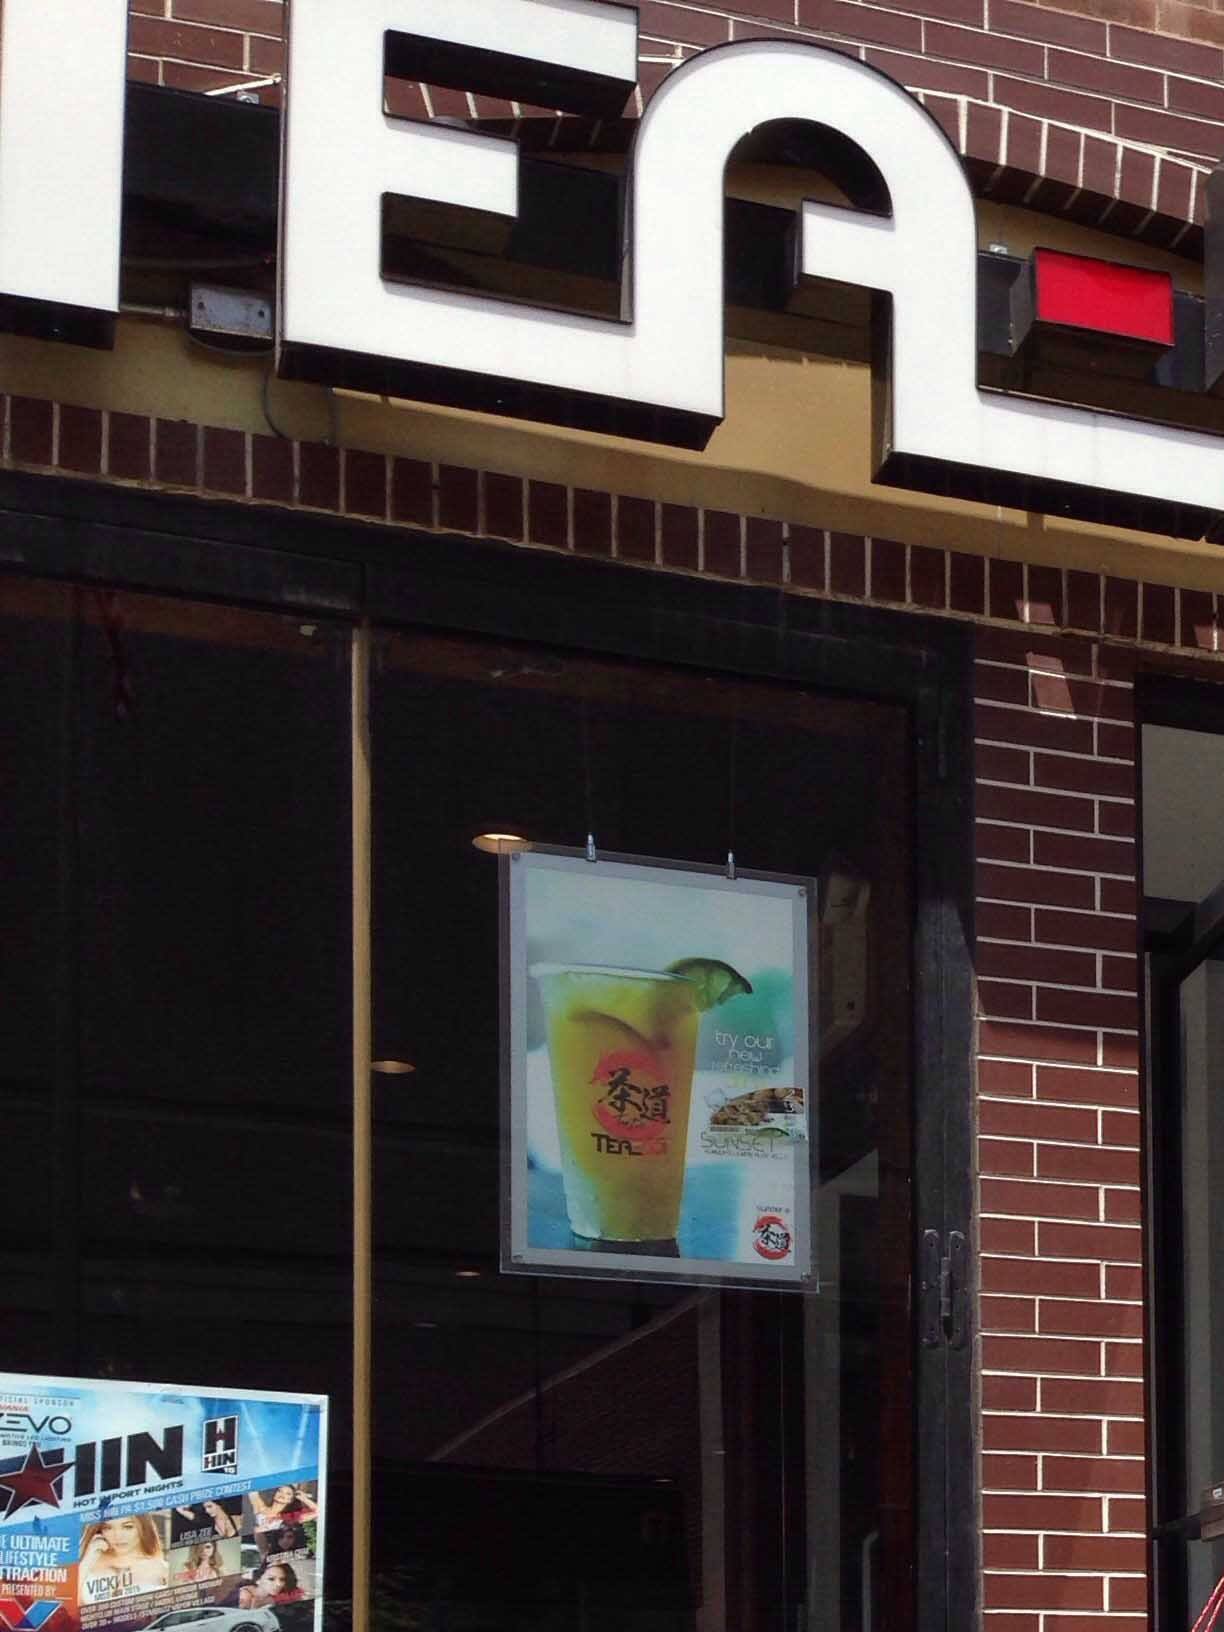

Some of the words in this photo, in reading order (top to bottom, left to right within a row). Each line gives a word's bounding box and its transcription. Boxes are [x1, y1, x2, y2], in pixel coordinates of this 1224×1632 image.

[714, 1031, 738, 1047] try
[744, 1035, 775, 1049] our
[73, 1498, 97, 1508] HOT
[143, 1479, 184, 1495] NIGHTS
[10, 1535, 71, 1552] ULTIMATE
